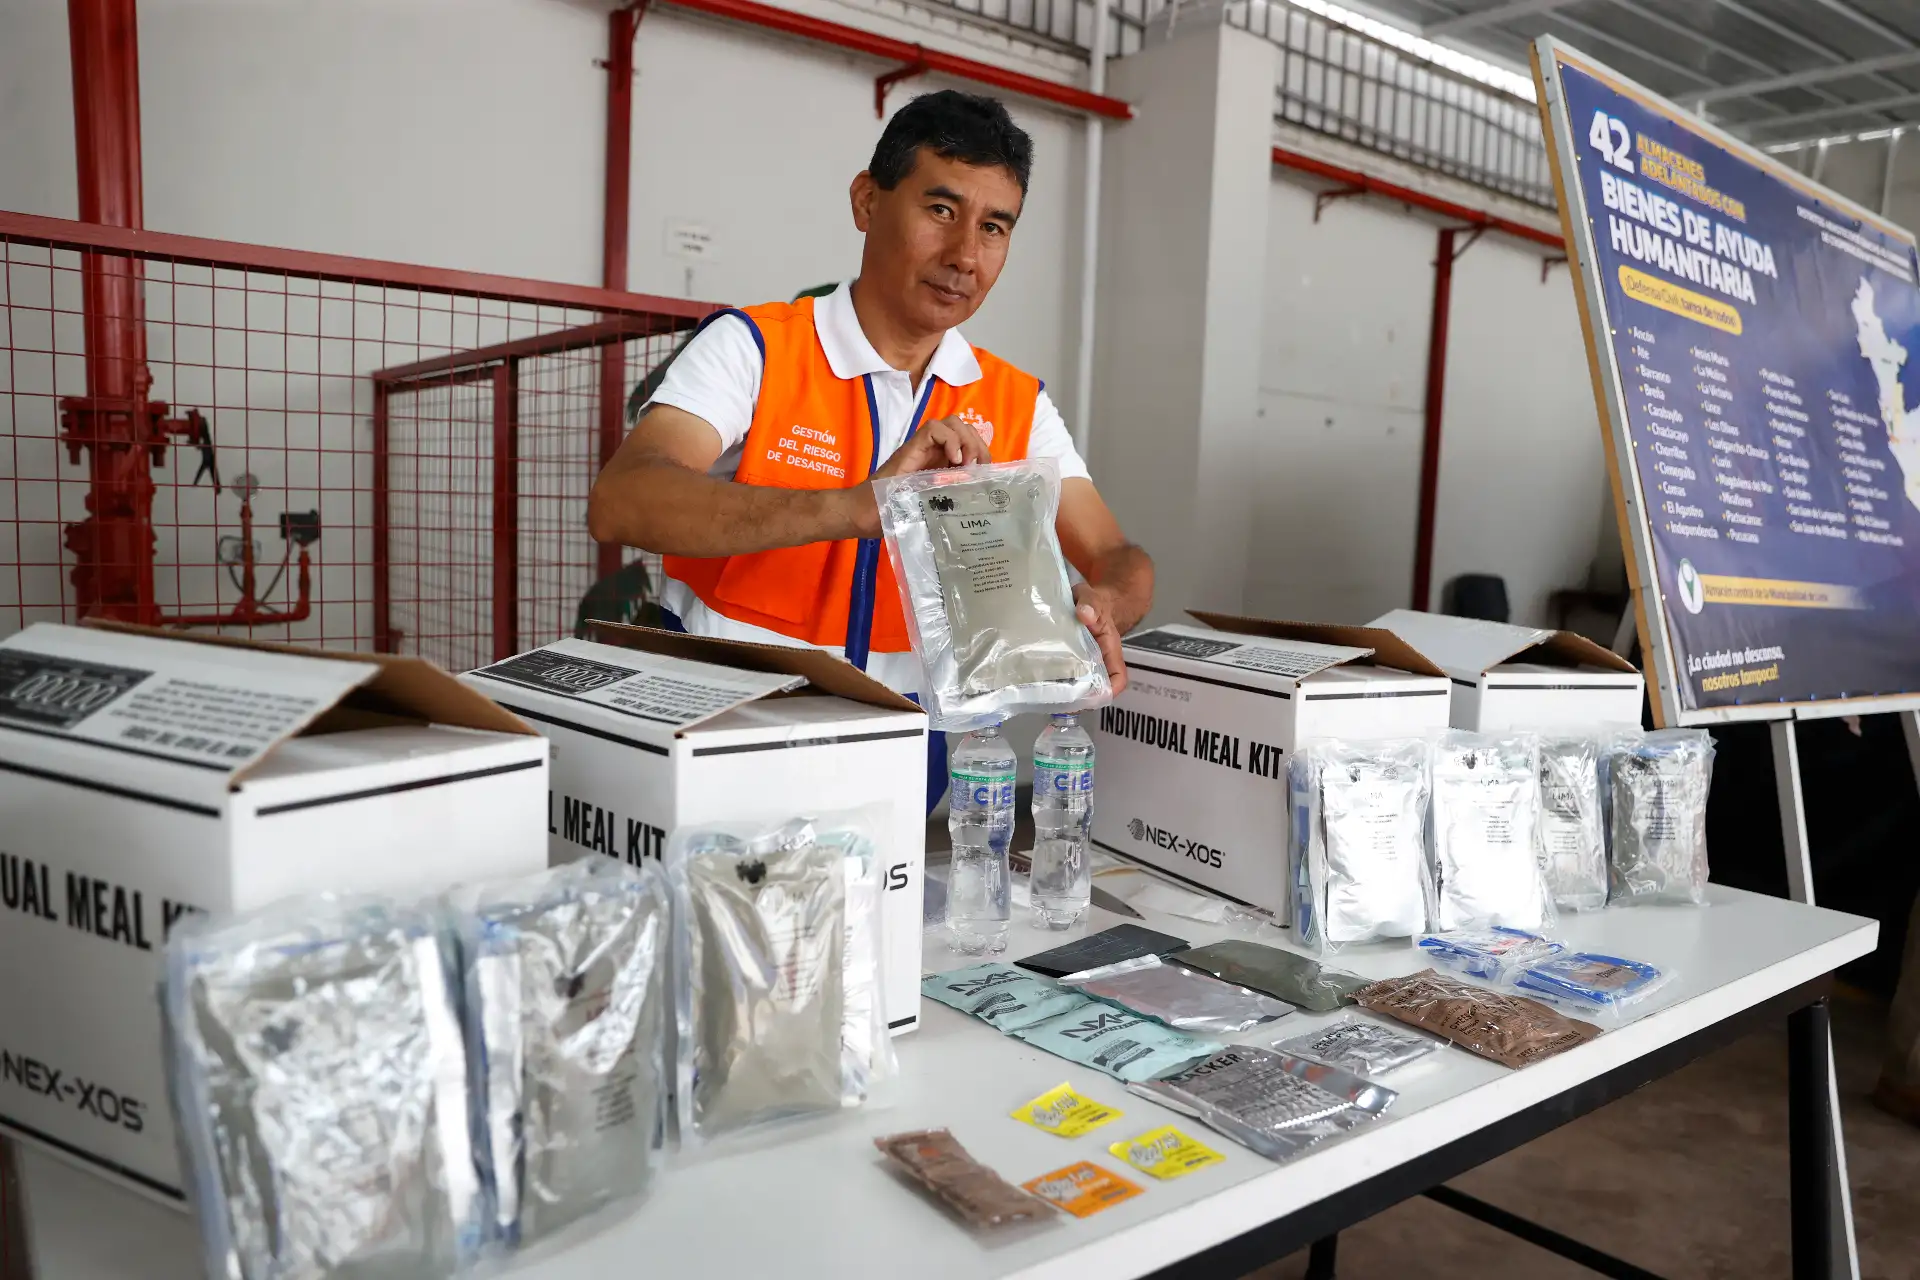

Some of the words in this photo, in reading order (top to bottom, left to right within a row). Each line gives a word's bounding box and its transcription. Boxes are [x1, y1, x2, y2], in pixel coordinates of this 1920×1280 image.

[1589, 109, 1634, 174] 42
[1600, 170, 1682, 237] BIENES
[1682, 212, 1712, 250] DE
[1715, 221, 1778, 279] AYUDA
[1608, 214, 1757, 305] HUMANITARIA
[778, 437, 799, 452] DEL
[803, 443, 841, 463] RIESGO
[791, 424, 836, 446] GESTIÓN
[766, 449, 783, 463] DE
[786, 454, 845, 479] DESASTRES
[960, 519, 992, 529] LIMA
[1702, 649, 1731, 671] ciudad
[1732, 650, 1744, 666] no
[1744, 645, 1785, 664] descansa,
[1702, 672, 1740, 692] nosotros
[1740, 663, 1779, 686] tampoco!
[1100, 705, 1188, 756] INDIVIDUAL
[1194, 727, 1242, 771] MEAL
[1249, 742, 1284, 780] KIT
[563, 795, 619, 860] MEAL
[627, 816, 666, 868] KIT
[1145, 826, 1222, 869] NEX-XOS
[65, 871, 152, 951] MEAL
[1161, 1052, 1245, 1085] ACKER
[2, 1048, 144, 1133] NEX-XOS
